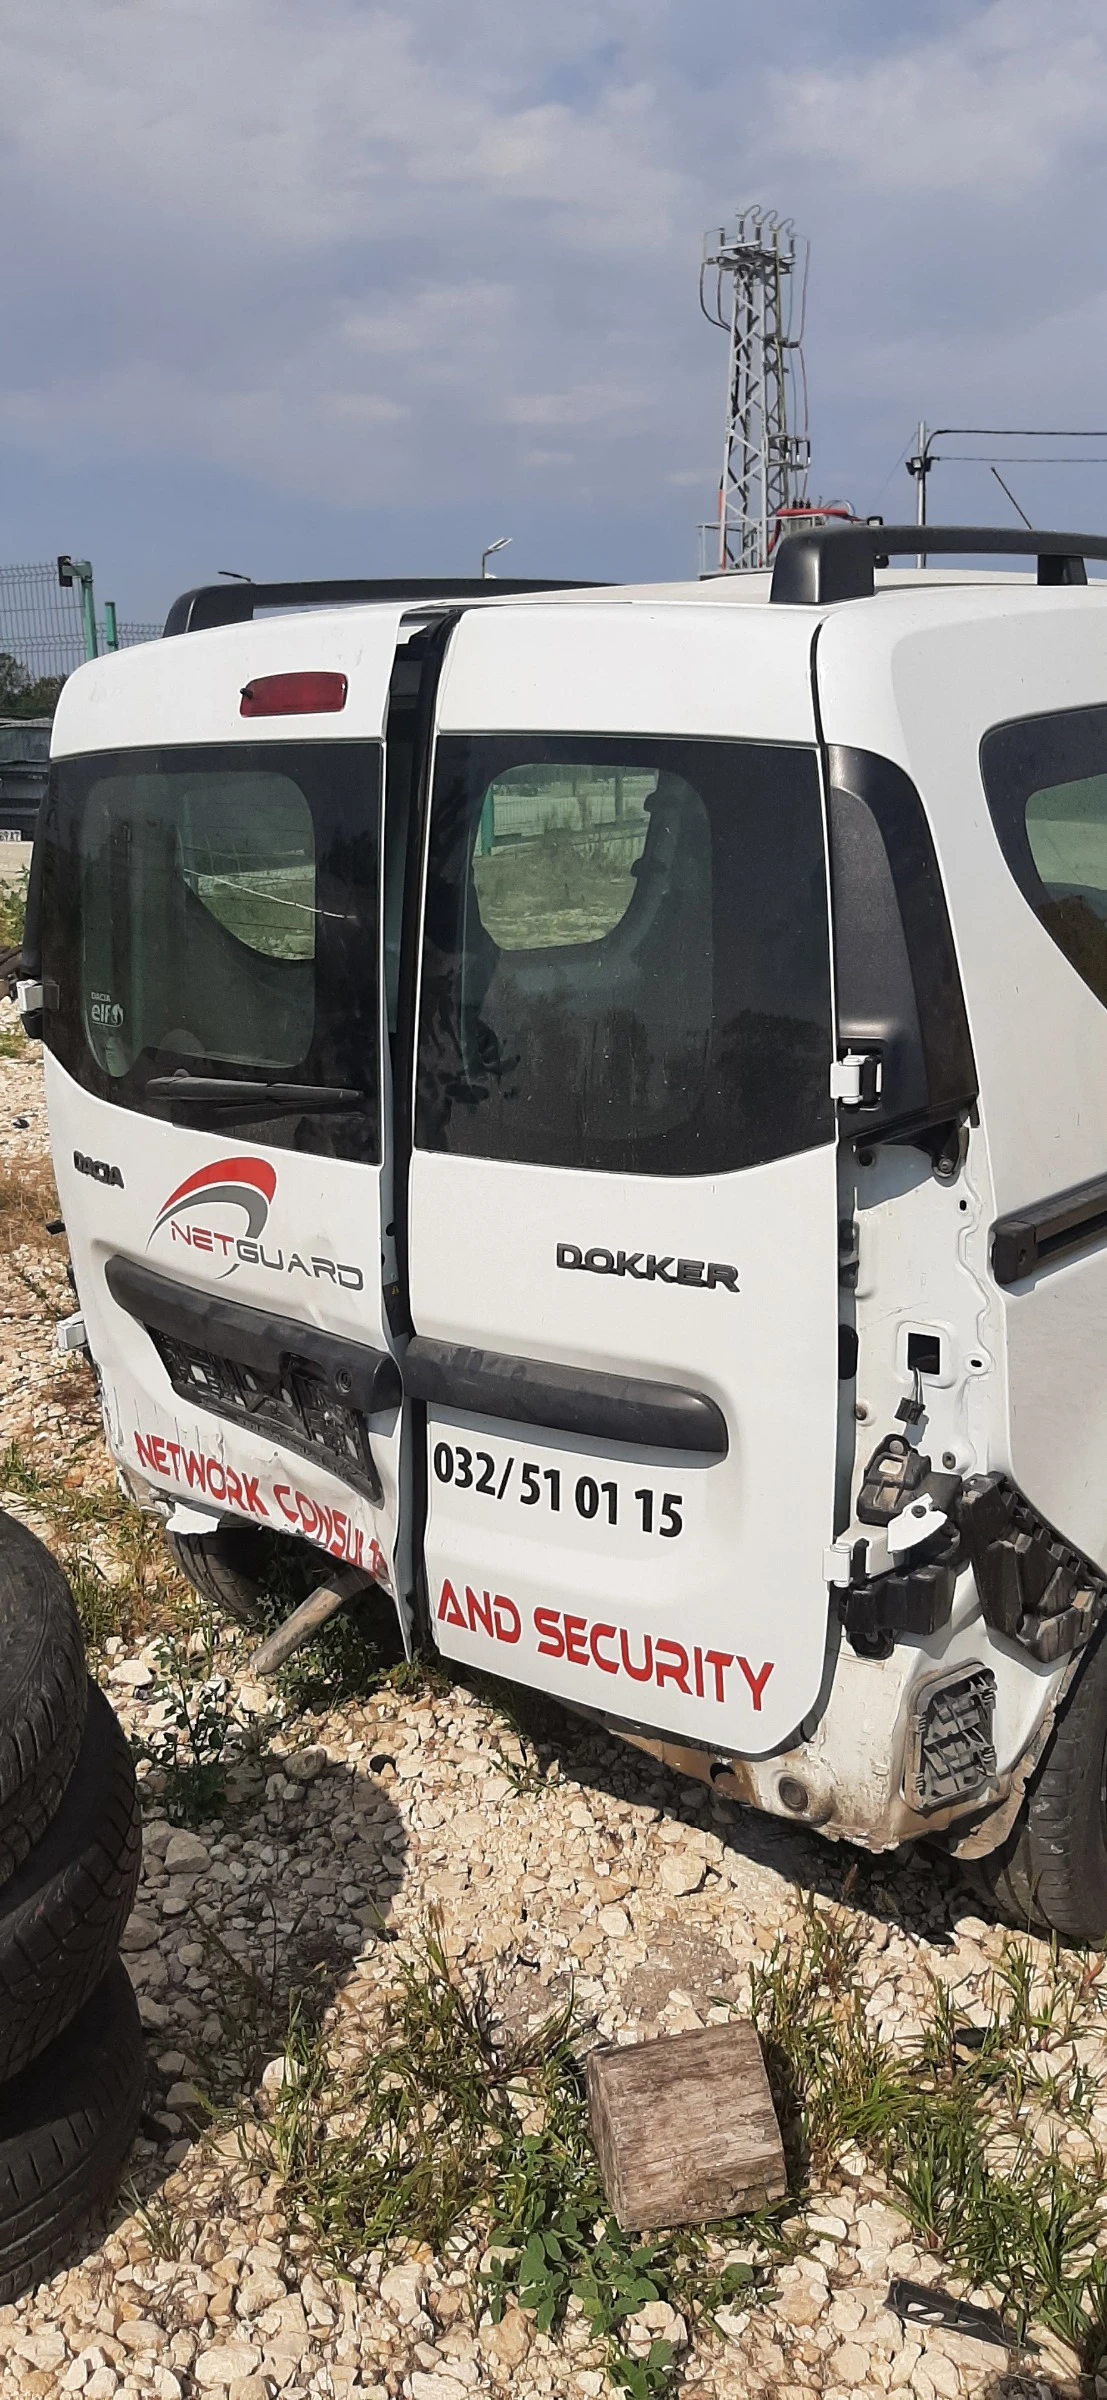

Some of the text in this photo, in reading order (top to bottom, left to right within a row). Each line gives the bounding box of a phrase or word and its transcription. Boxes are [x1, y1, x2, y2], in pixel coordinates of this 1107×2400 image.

[91, 991, 111, 1002] DACIA
[91, 1003, 111, 1023] elf
[73, 1150, 125, 1189] DACIA
[170, 1220, 364, 1291] NETGUARD
[556, 1242, 741, 1293] DOKKER
[133, 1431, 270, 1515] NETWORK
[433, 1441, 515, 1500] 032/
[520, 1462, 560, 1512] 51
[575, 1475, 618, 1526] 01
[635, 1488, 683, 1538] 15
[437, 1578, 775, 1711] AND SECURITY
